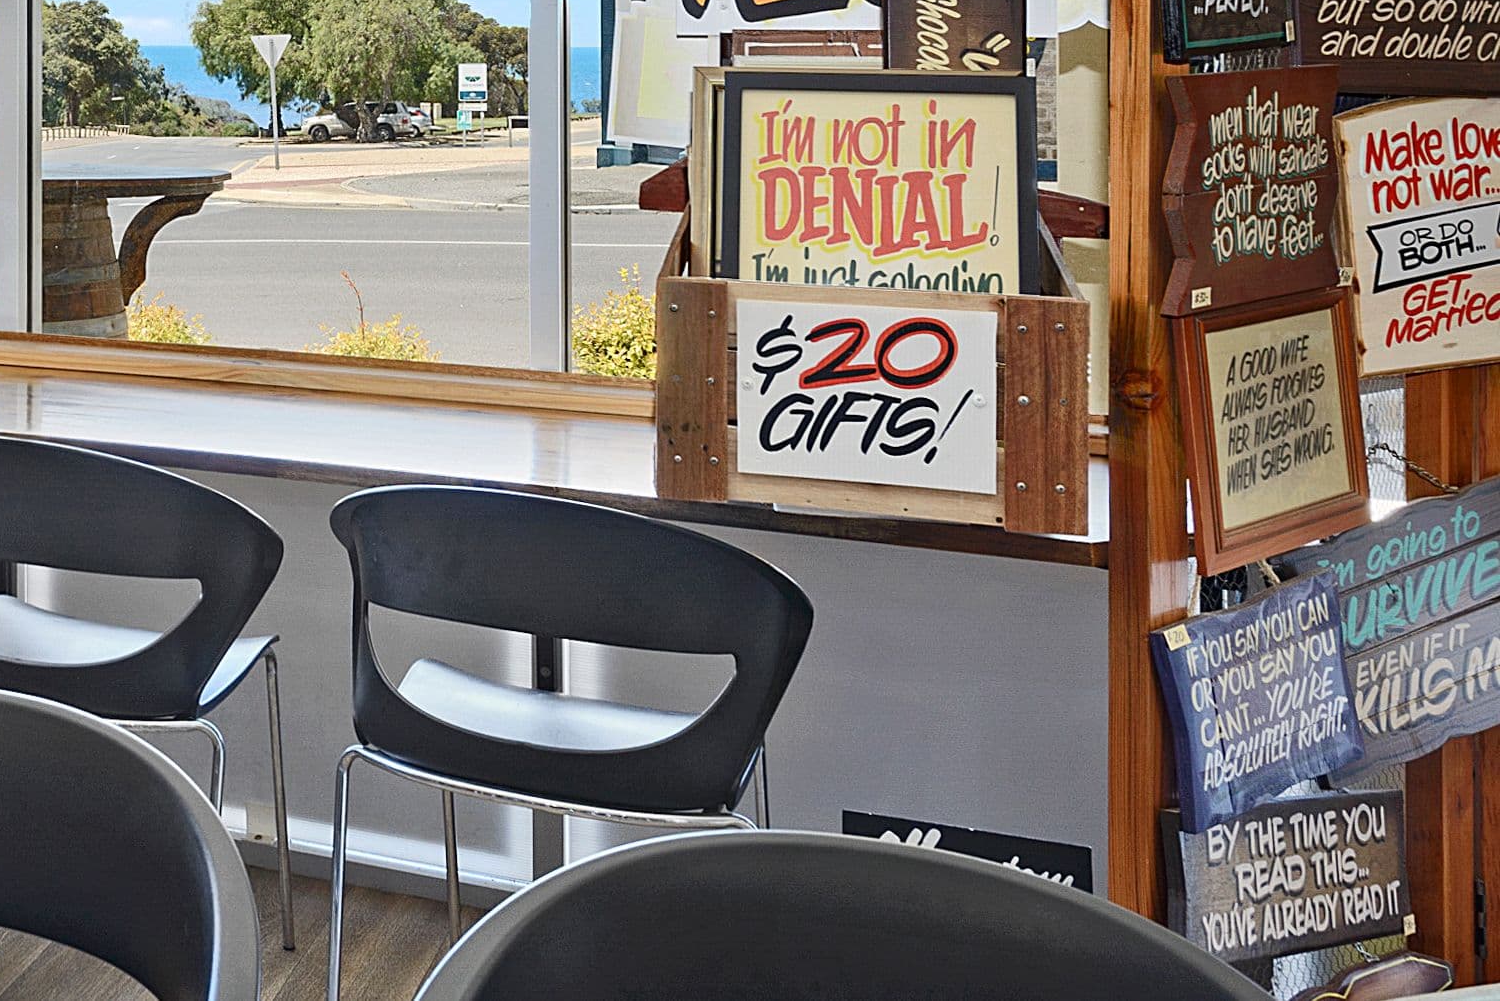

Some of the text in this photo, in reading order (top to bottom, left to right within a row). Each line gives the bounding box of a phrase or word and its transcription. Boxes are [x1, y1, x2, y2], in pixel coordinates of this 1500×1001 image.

[758, 99, 976, 169] I'm not in
[1209, 86, 1319, 148] men that wear
[1366, 121, 1442, 173] Make
[757, 165, 1000, 258] DENIAL!
[1401, 220, 1473, 246] OR DO
[753, 315, 958, 394] $20
[1227, 334, 1309, 387] A GOOD WIFE
[759, 389, 973, 464] GIFTS!
[1185, 593, 1329, 679] IF YOU SAY YOU CAN
[1357, 624, 1471, 687] EVEN IF IT
[1207, 803, 1386, 866] BY THE TIME YOU
[1235, 854, 1302, 900] READ
